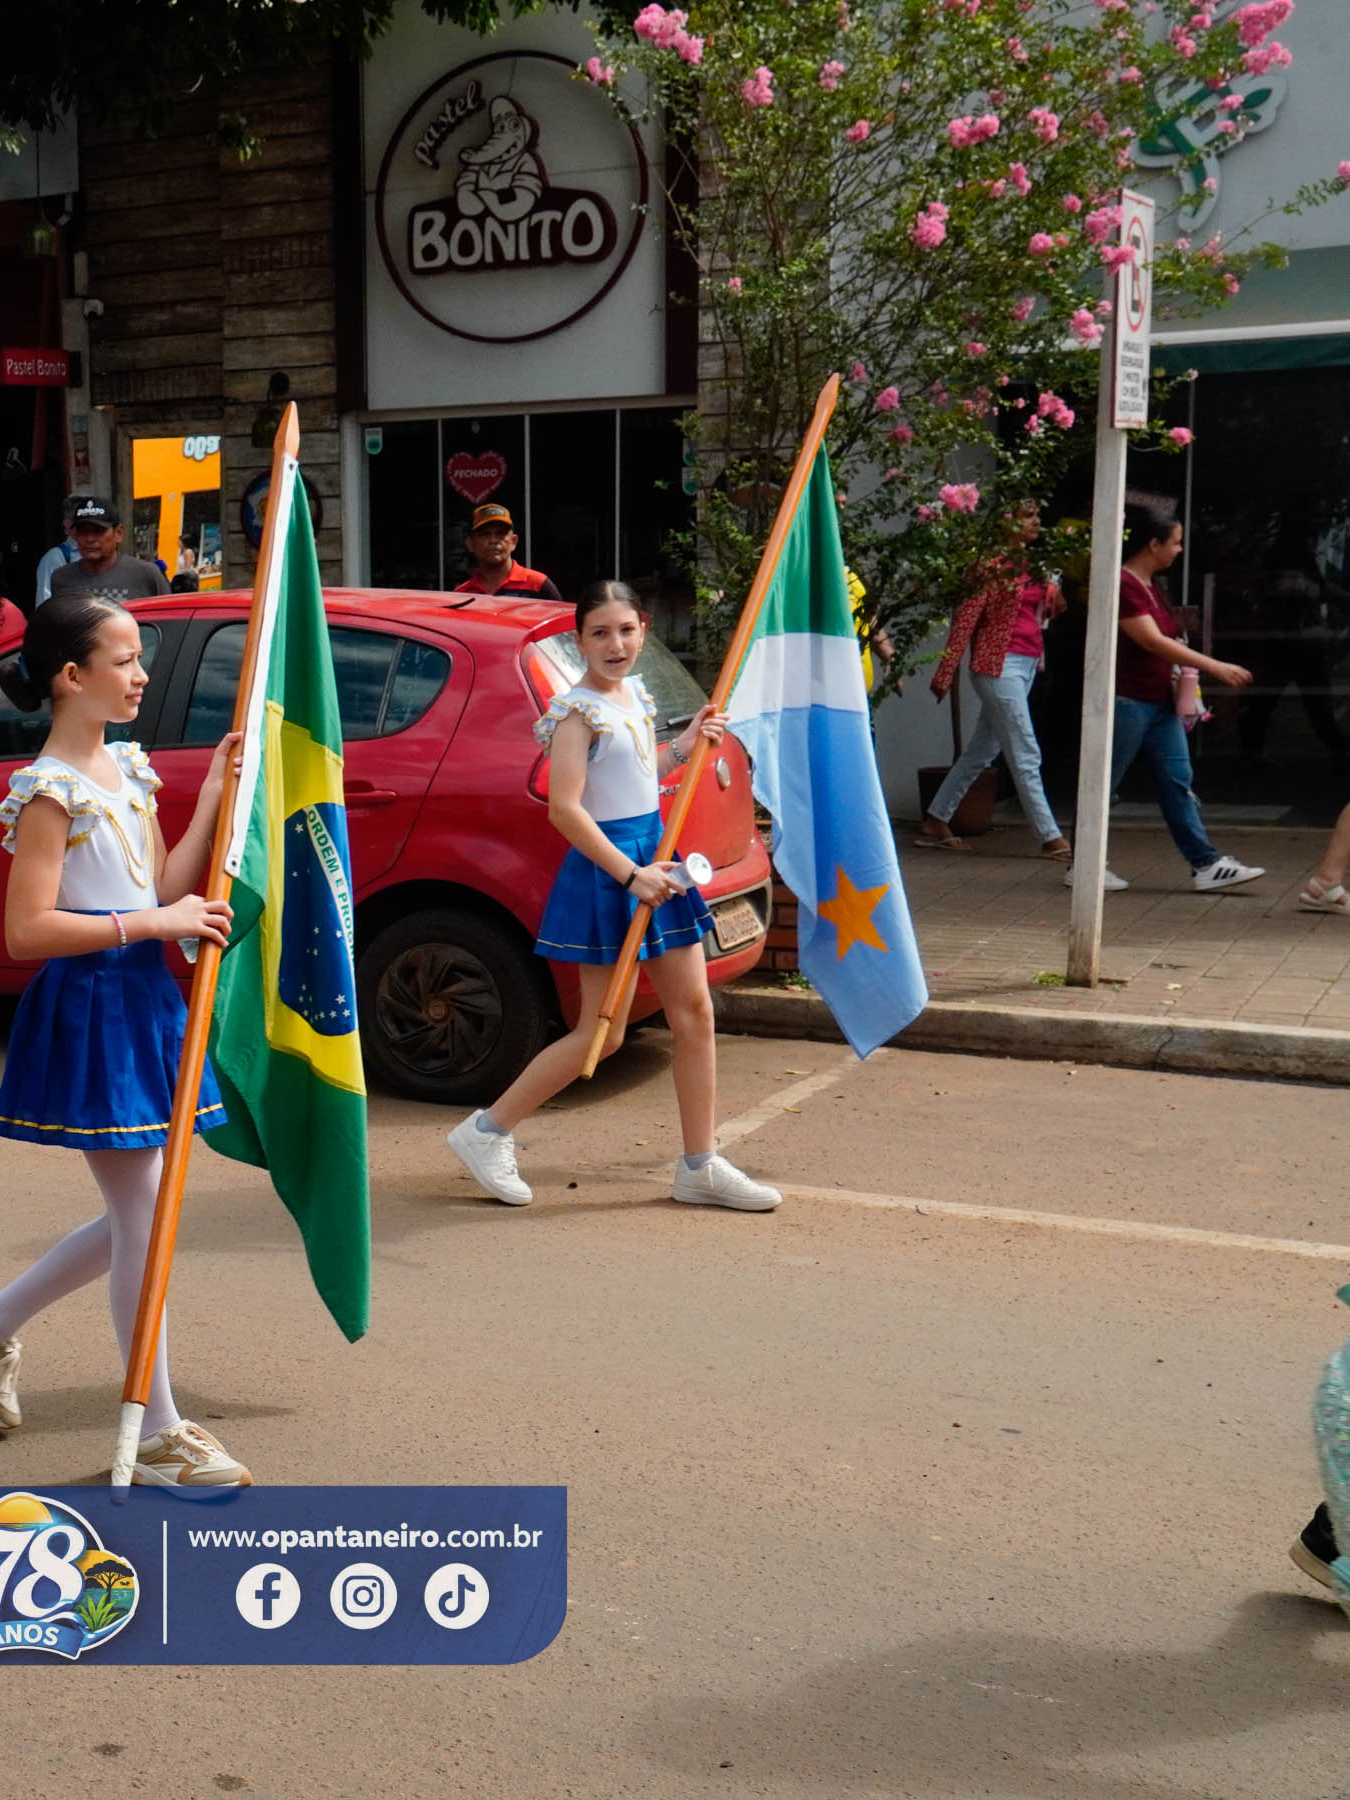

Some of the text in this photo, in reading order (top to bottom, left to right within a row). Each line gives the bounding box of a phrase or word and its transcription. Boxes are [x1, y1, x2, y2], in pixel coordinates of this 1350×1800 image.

[414, 80, 479, 166] pastel
[413, 198, 605, 268] BONITO
[6, 358, 66, 376] Pastel Bonito
[453, 468, 499, 478] FECHADO
[307, 809, 340, 873] ORDEM
[335, 878, 344, 887] E
